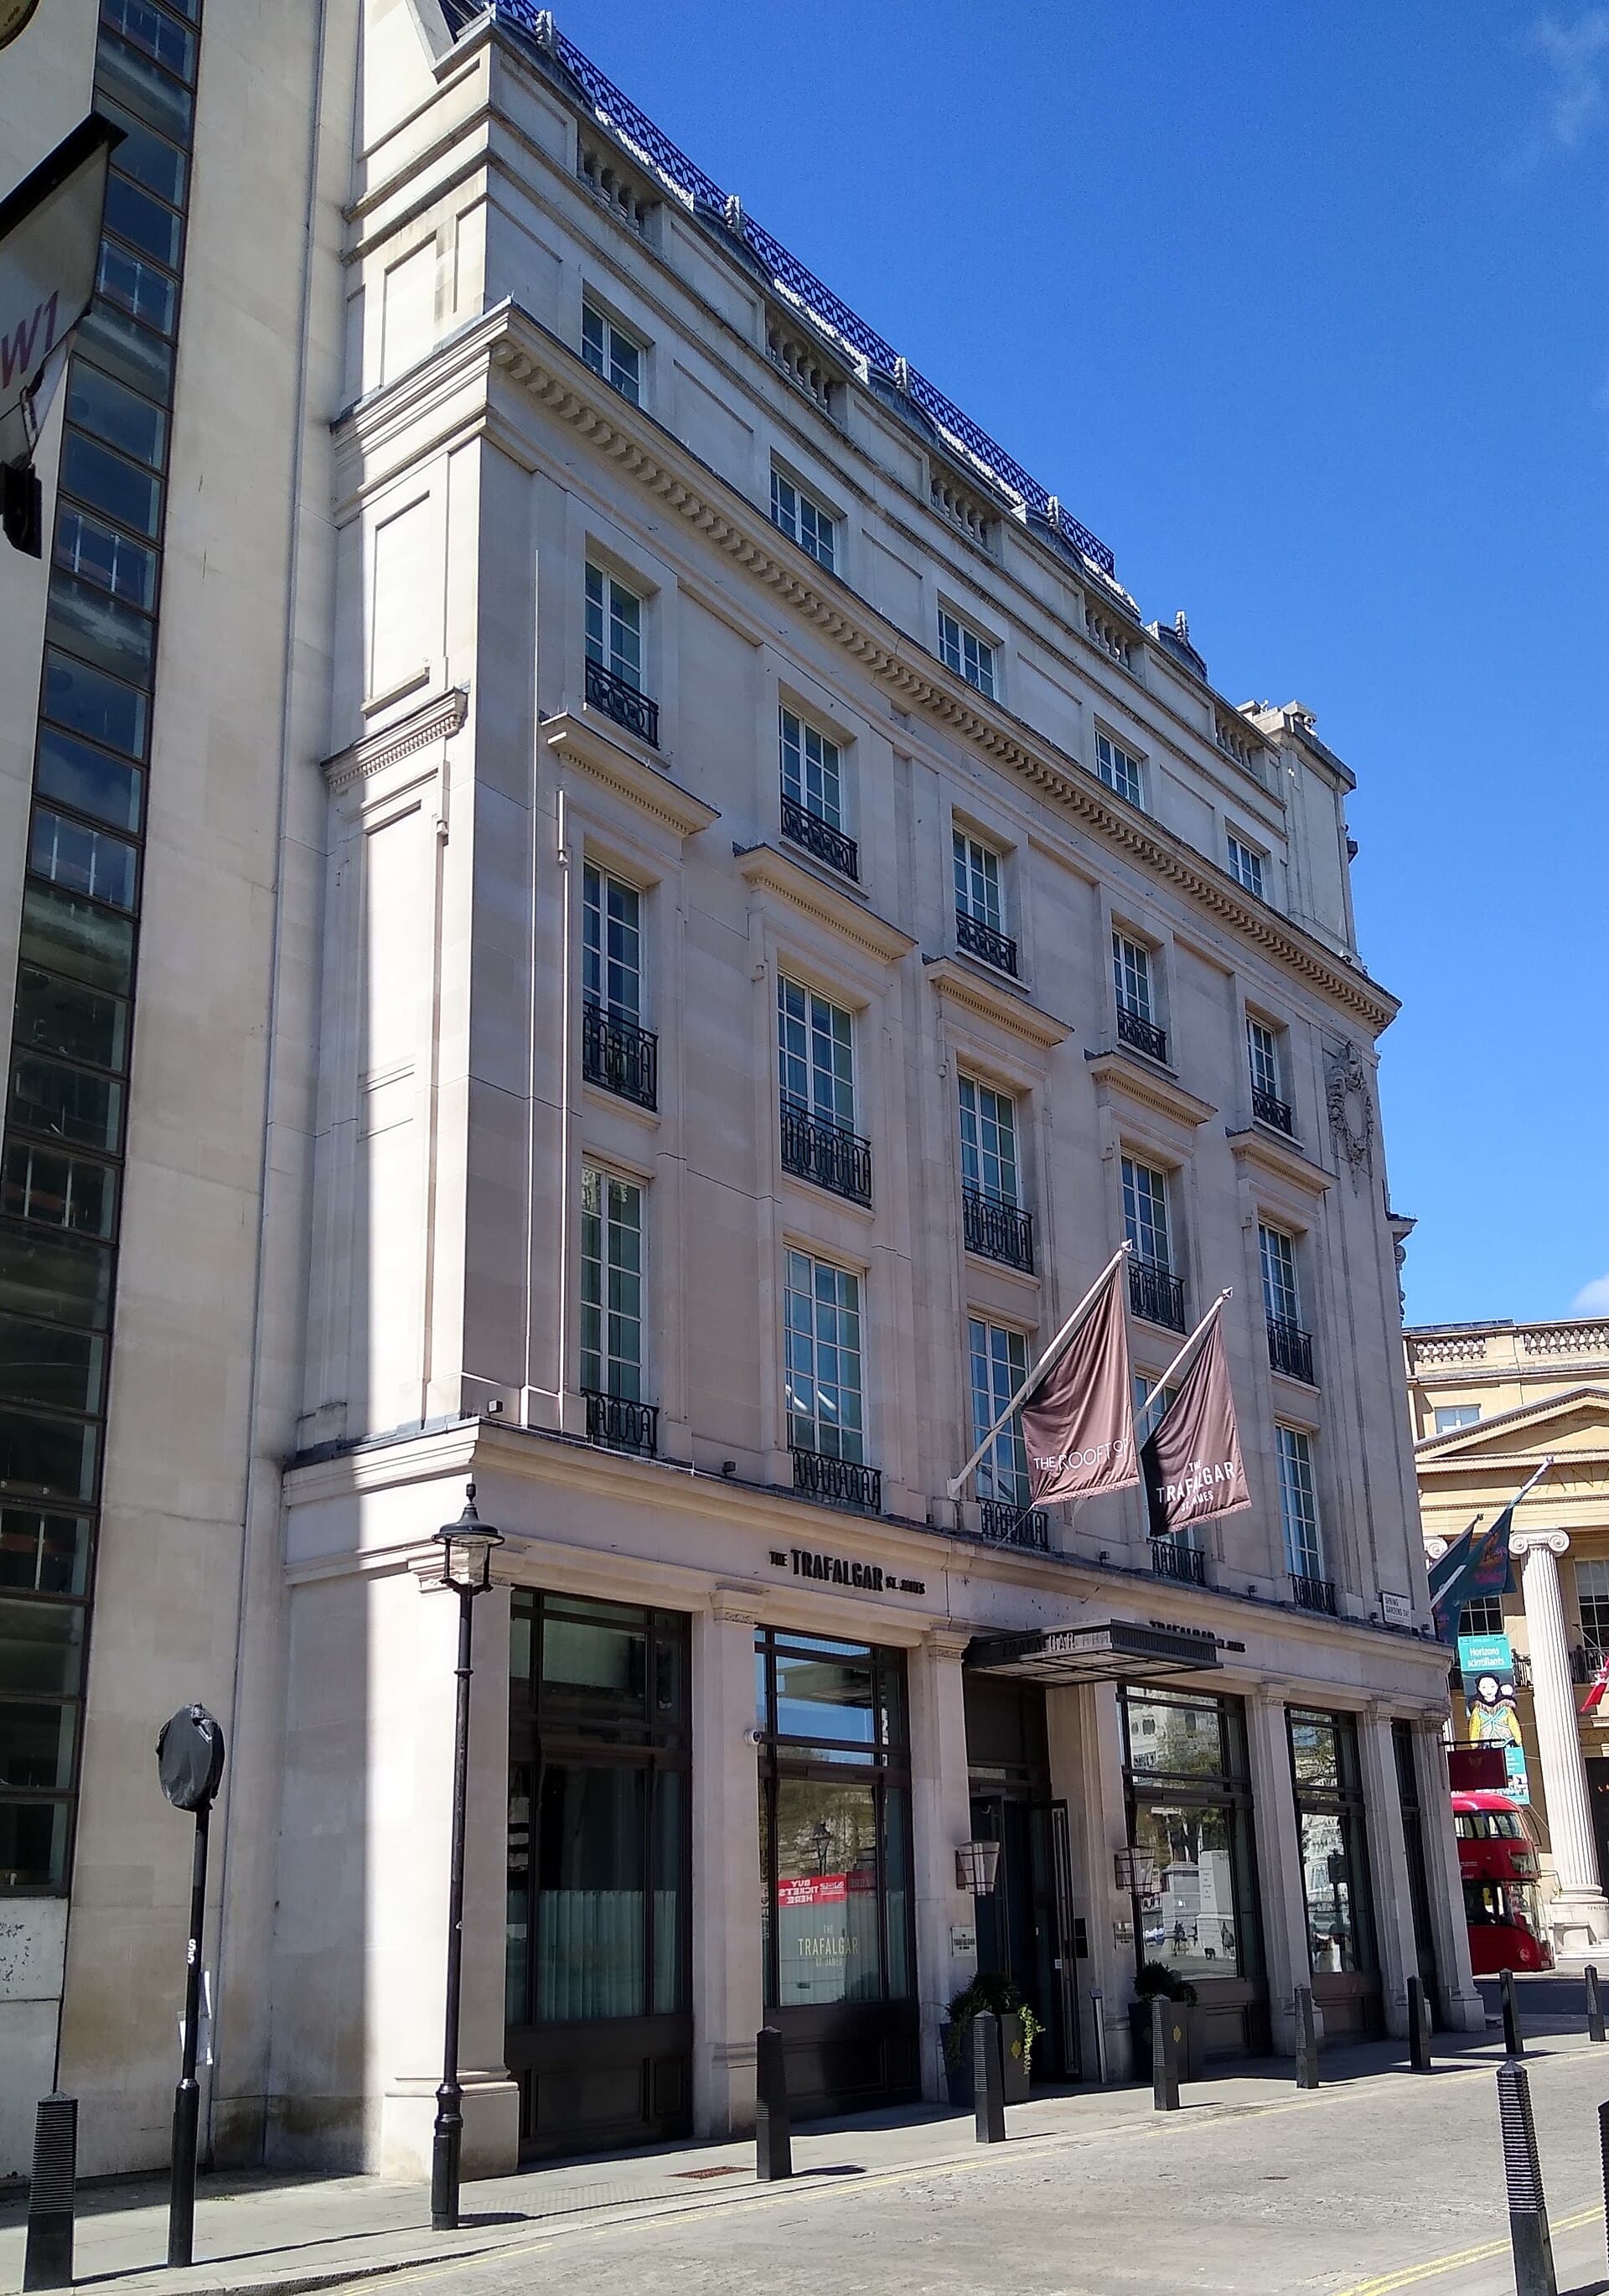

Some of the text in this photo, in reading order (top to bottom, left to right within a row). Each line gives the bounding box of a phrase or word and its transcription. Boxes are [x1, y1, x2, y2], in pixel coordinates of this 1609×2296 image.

[1033, 1438, 1129, 1471] THE ROOFTOP
[1188, 1459, 1202, 1473] THE
[1156, 1461, 1234, 1503] TRAFALGAR
[790, 1549, 883, 1592] TRAFALGAR
[1469, 1647, 1500, 1657] Horizons
[798, 1937, 858, 1956] TRAFALGAR
